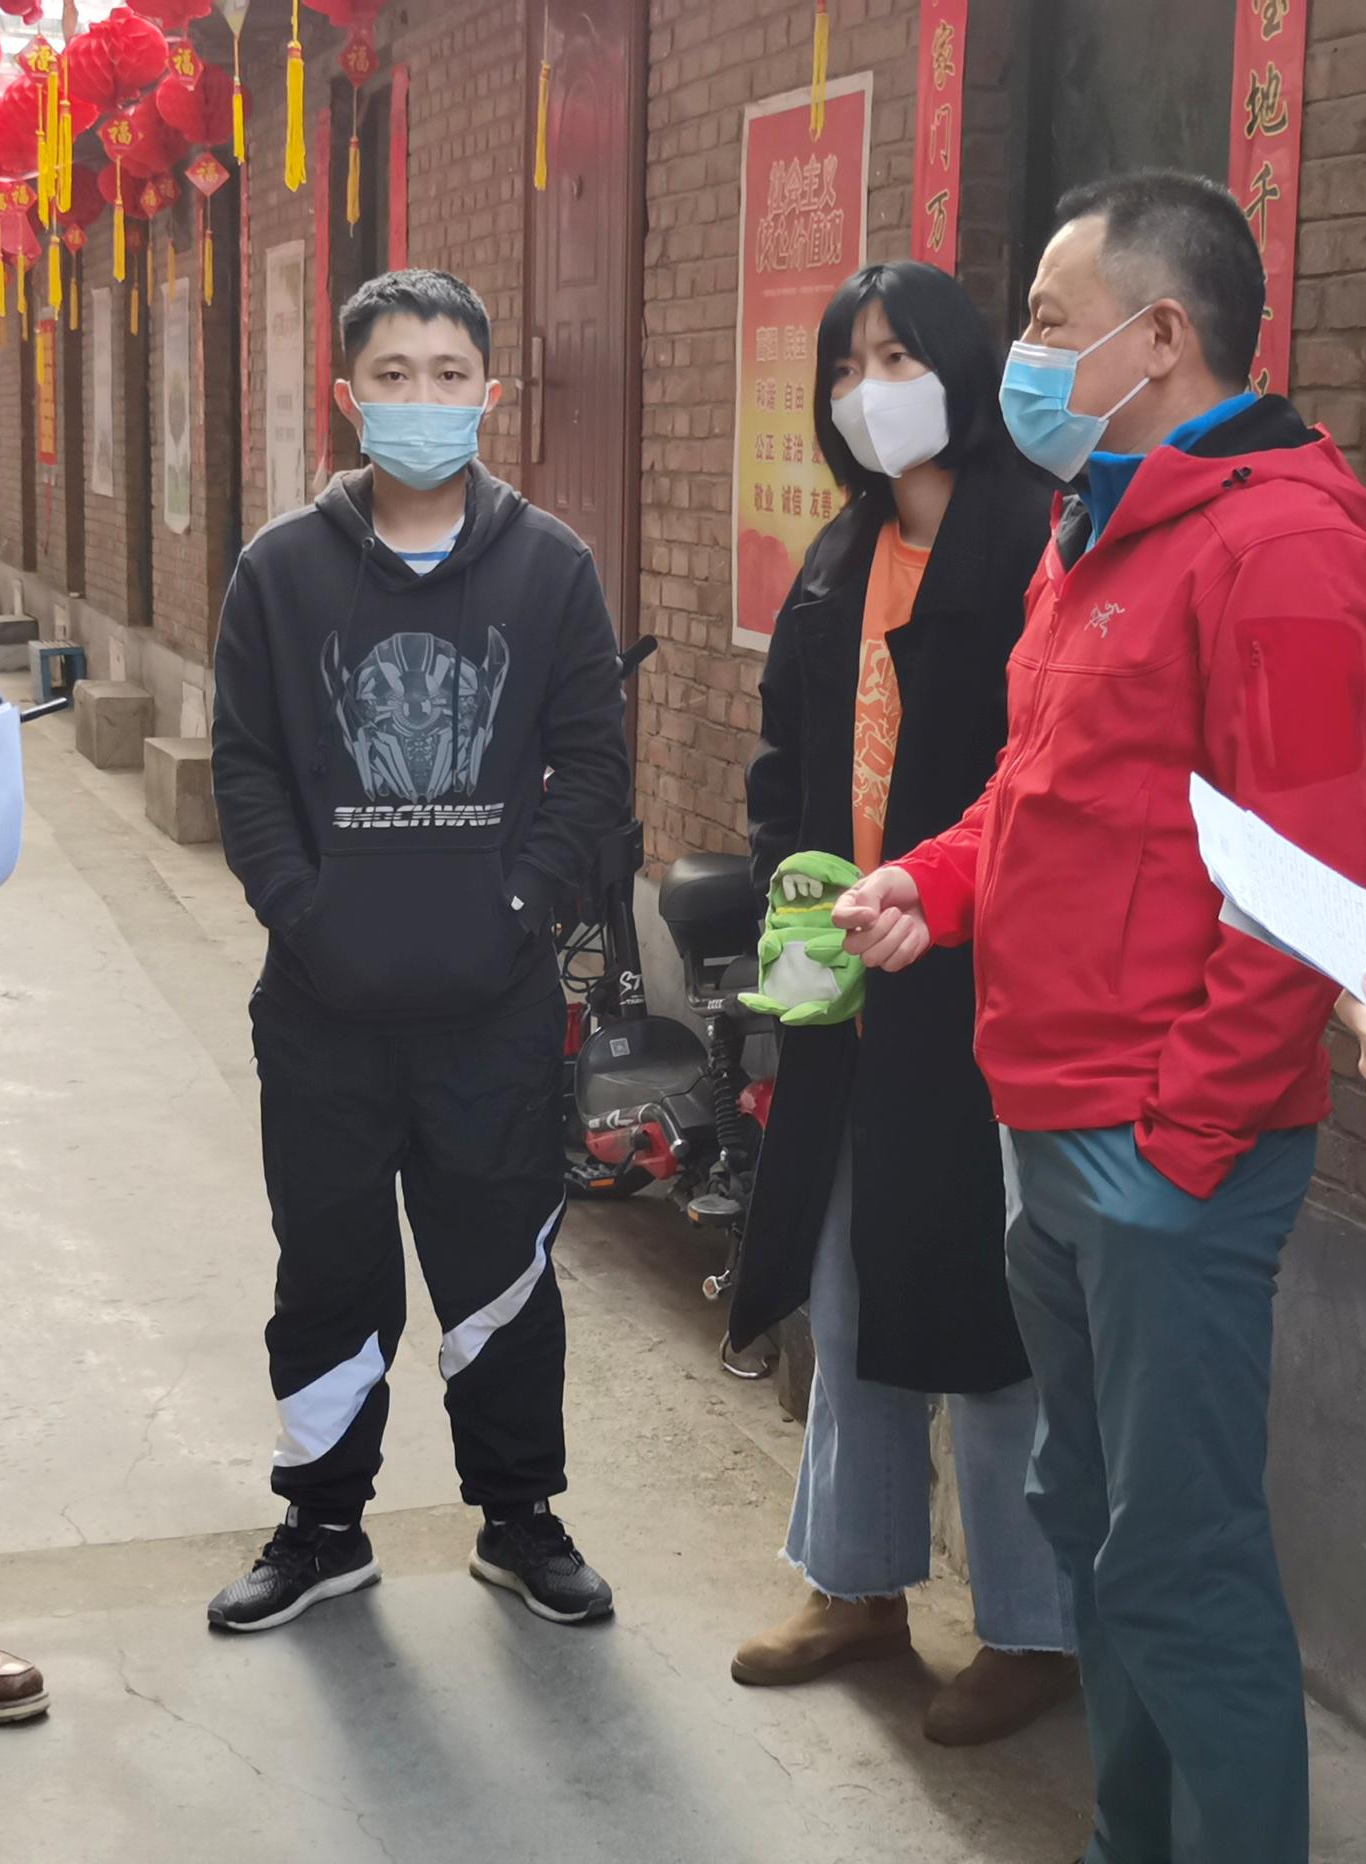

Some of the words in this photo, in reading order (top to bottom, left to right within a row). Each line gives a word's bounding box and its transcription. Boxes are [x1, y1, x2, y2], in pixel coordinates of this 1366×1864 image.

[27, 45, 53, 72] 福
[172, 48, 194, 77] 福
[347, 46, 370, 72] 福
[107, 120, 133, 145] 福
[196, 161, 219, 182] 福
[767, 152, 839, 216] 社会主义
[755, 209, 845, 274] 核心价值观
[756, 433, 775, 461] 公正
[782, 433, 803, 464] 法治
[754, 483, 774, 512] 敬业
[782, 485, 803, 516] 诚信
[810, 487, 832, 519] 友善
